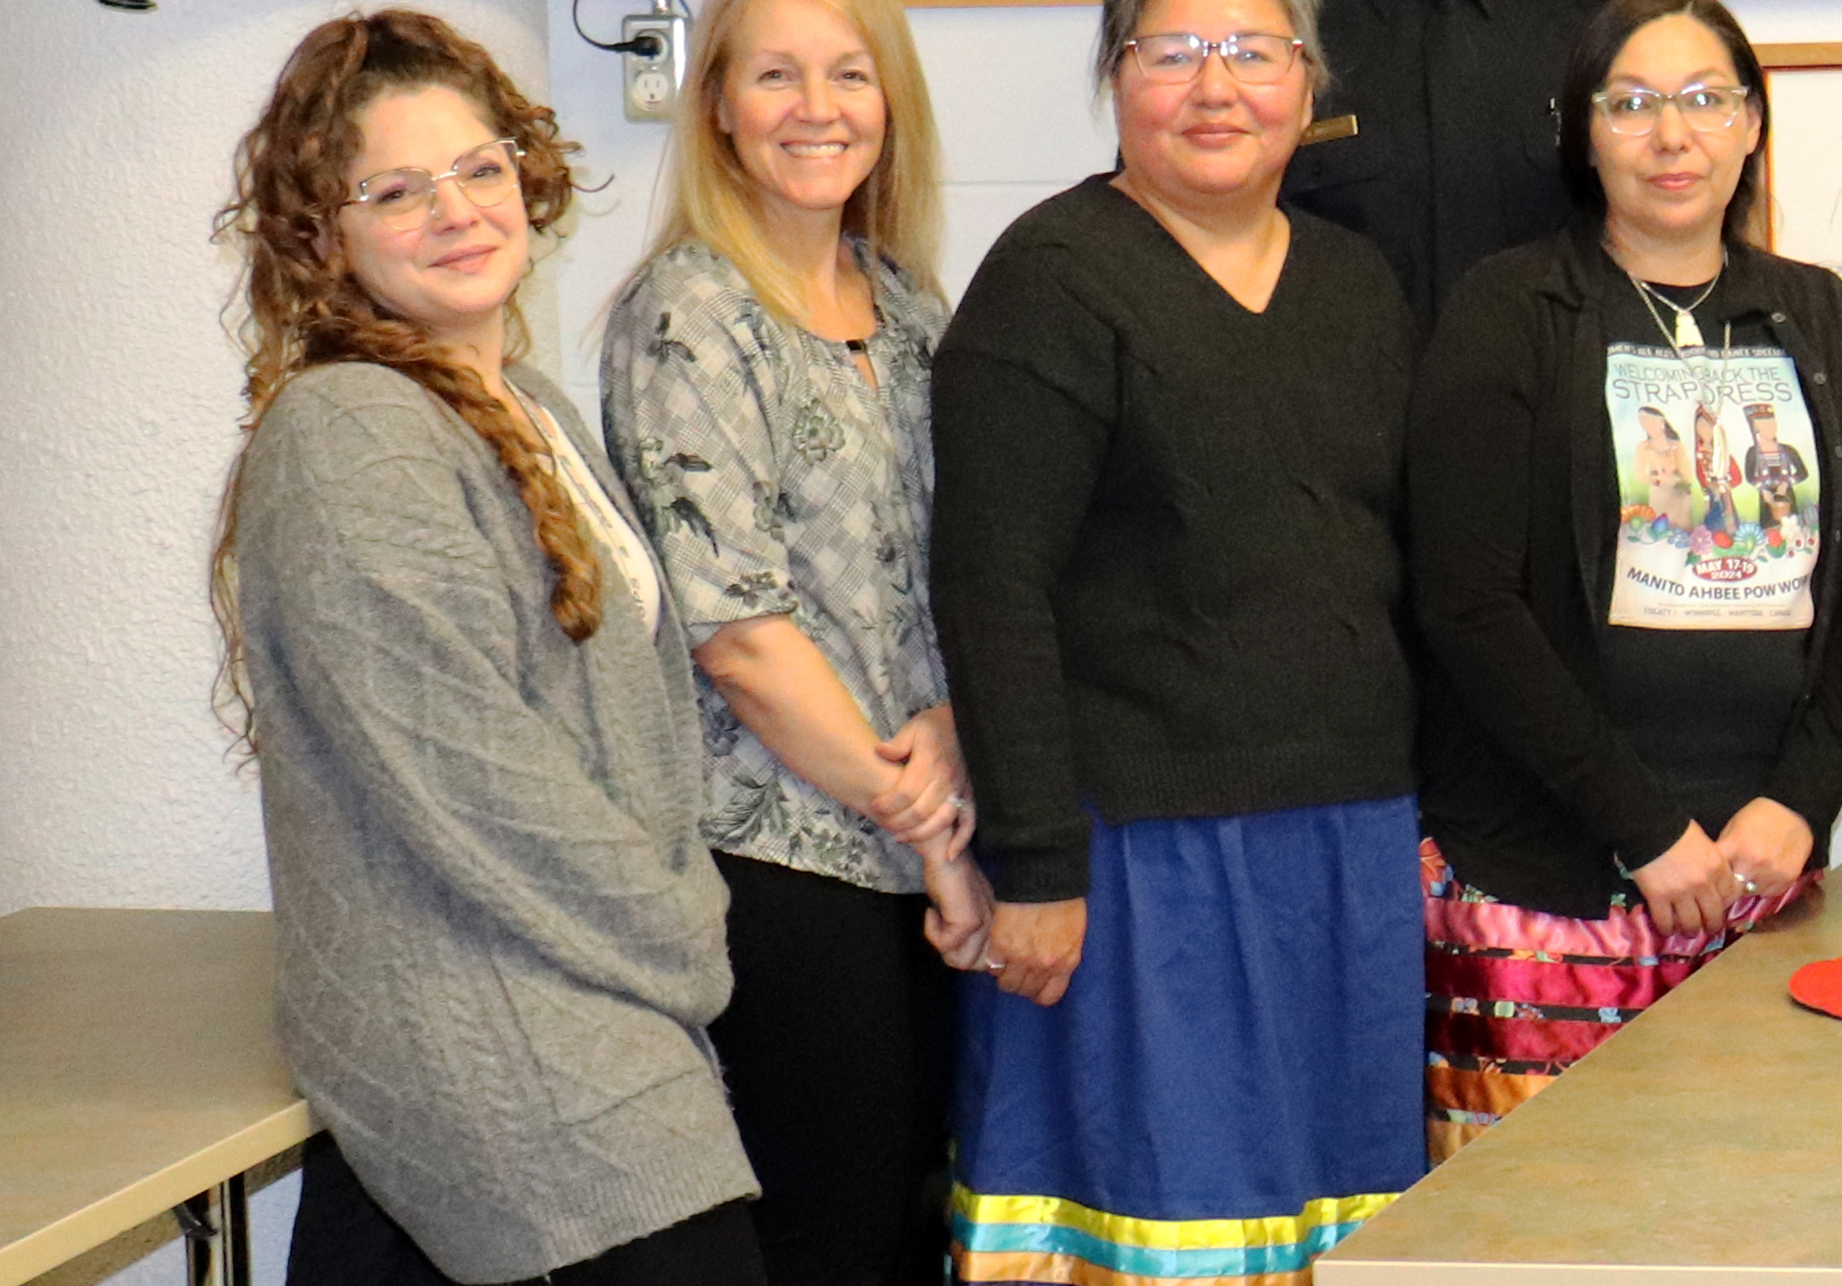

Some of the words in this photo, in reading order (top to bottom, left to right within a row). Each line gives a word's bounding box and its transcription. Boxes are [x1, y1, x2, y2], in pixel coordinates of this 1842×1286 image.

[1746, 366, 1781, 381] THE
[1612, 378, 1698, 405] STRAP
[1702, 381, 1793, 406] DRESS
[1696, 560, 1722, 575] MAY
[1710, 570, 1743, 580] 2024
[1626, 566, 1685, 597] MANITO
[1688, 585, 1741, 600] AHBEE
[1744, 583, 1777, 599] POW
